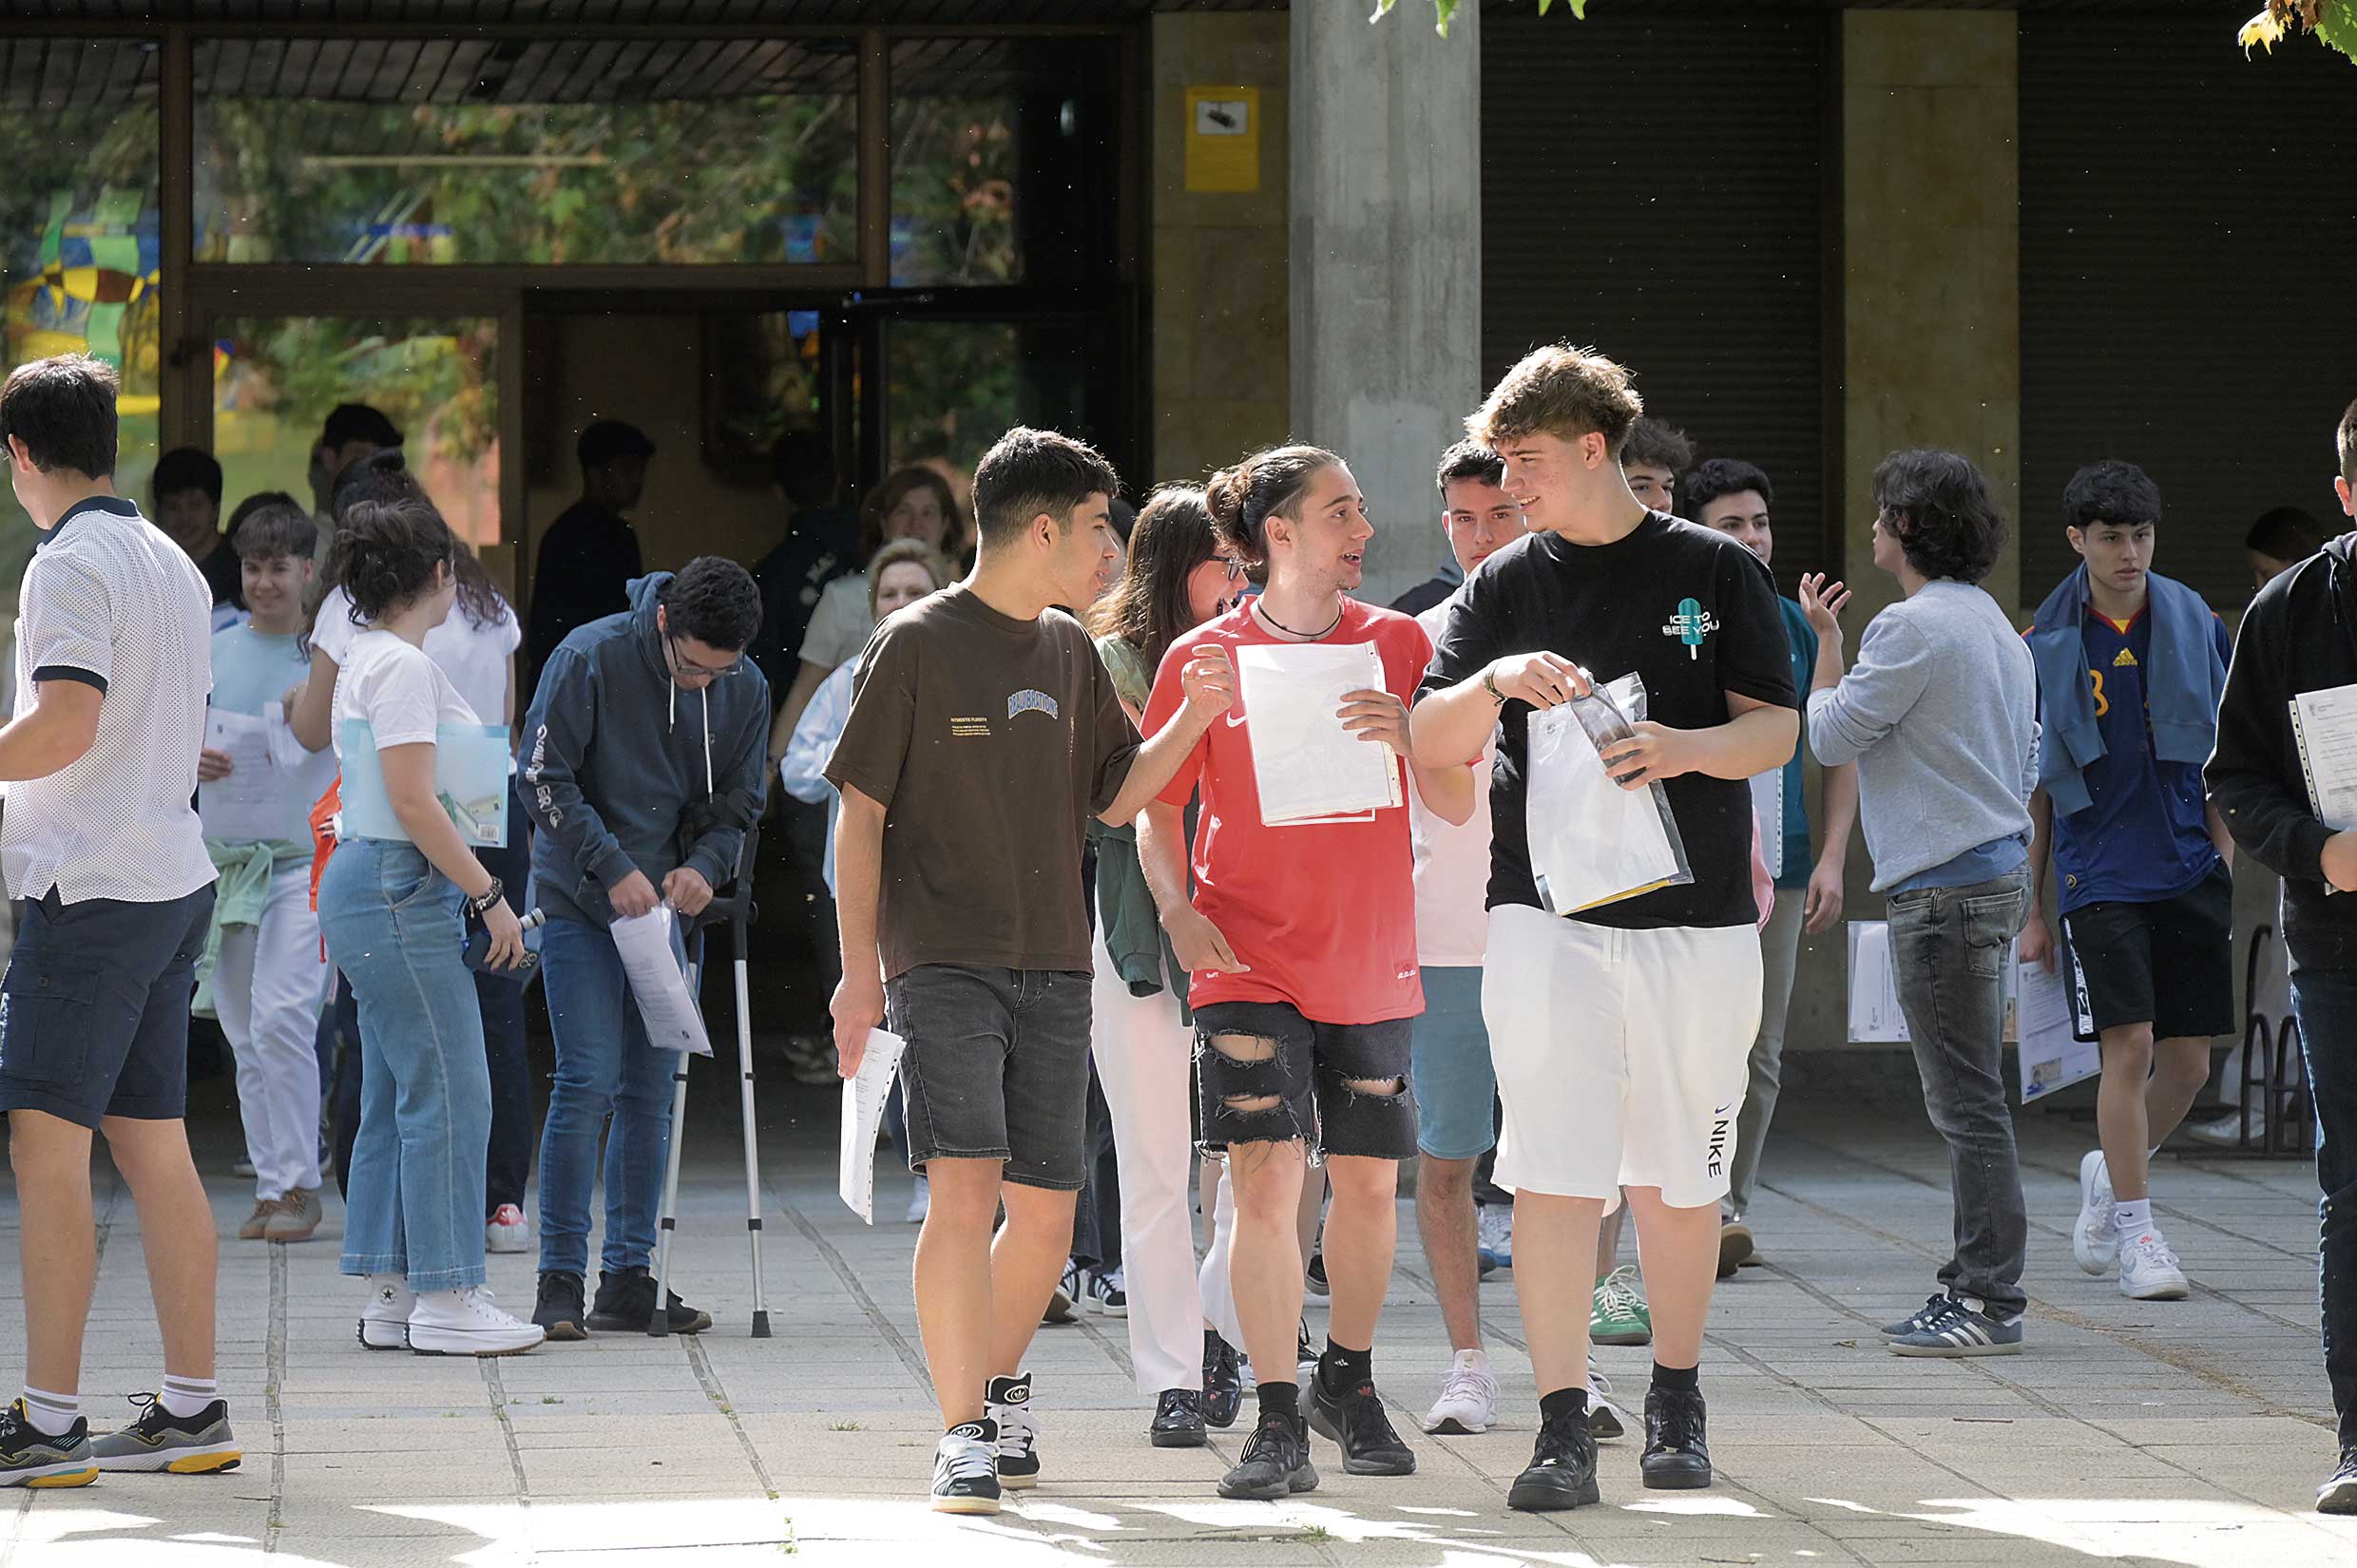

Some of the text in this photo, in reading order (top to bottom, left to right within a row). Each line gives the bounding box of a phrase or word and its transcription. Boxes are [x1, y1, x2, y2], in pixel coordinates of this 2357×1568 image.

[1669, 611, 1711, 624] ICE TO
[1662, 620, 1719, 636] SEE YOU
[1708, 1119, 1729, 1178] NIKE
